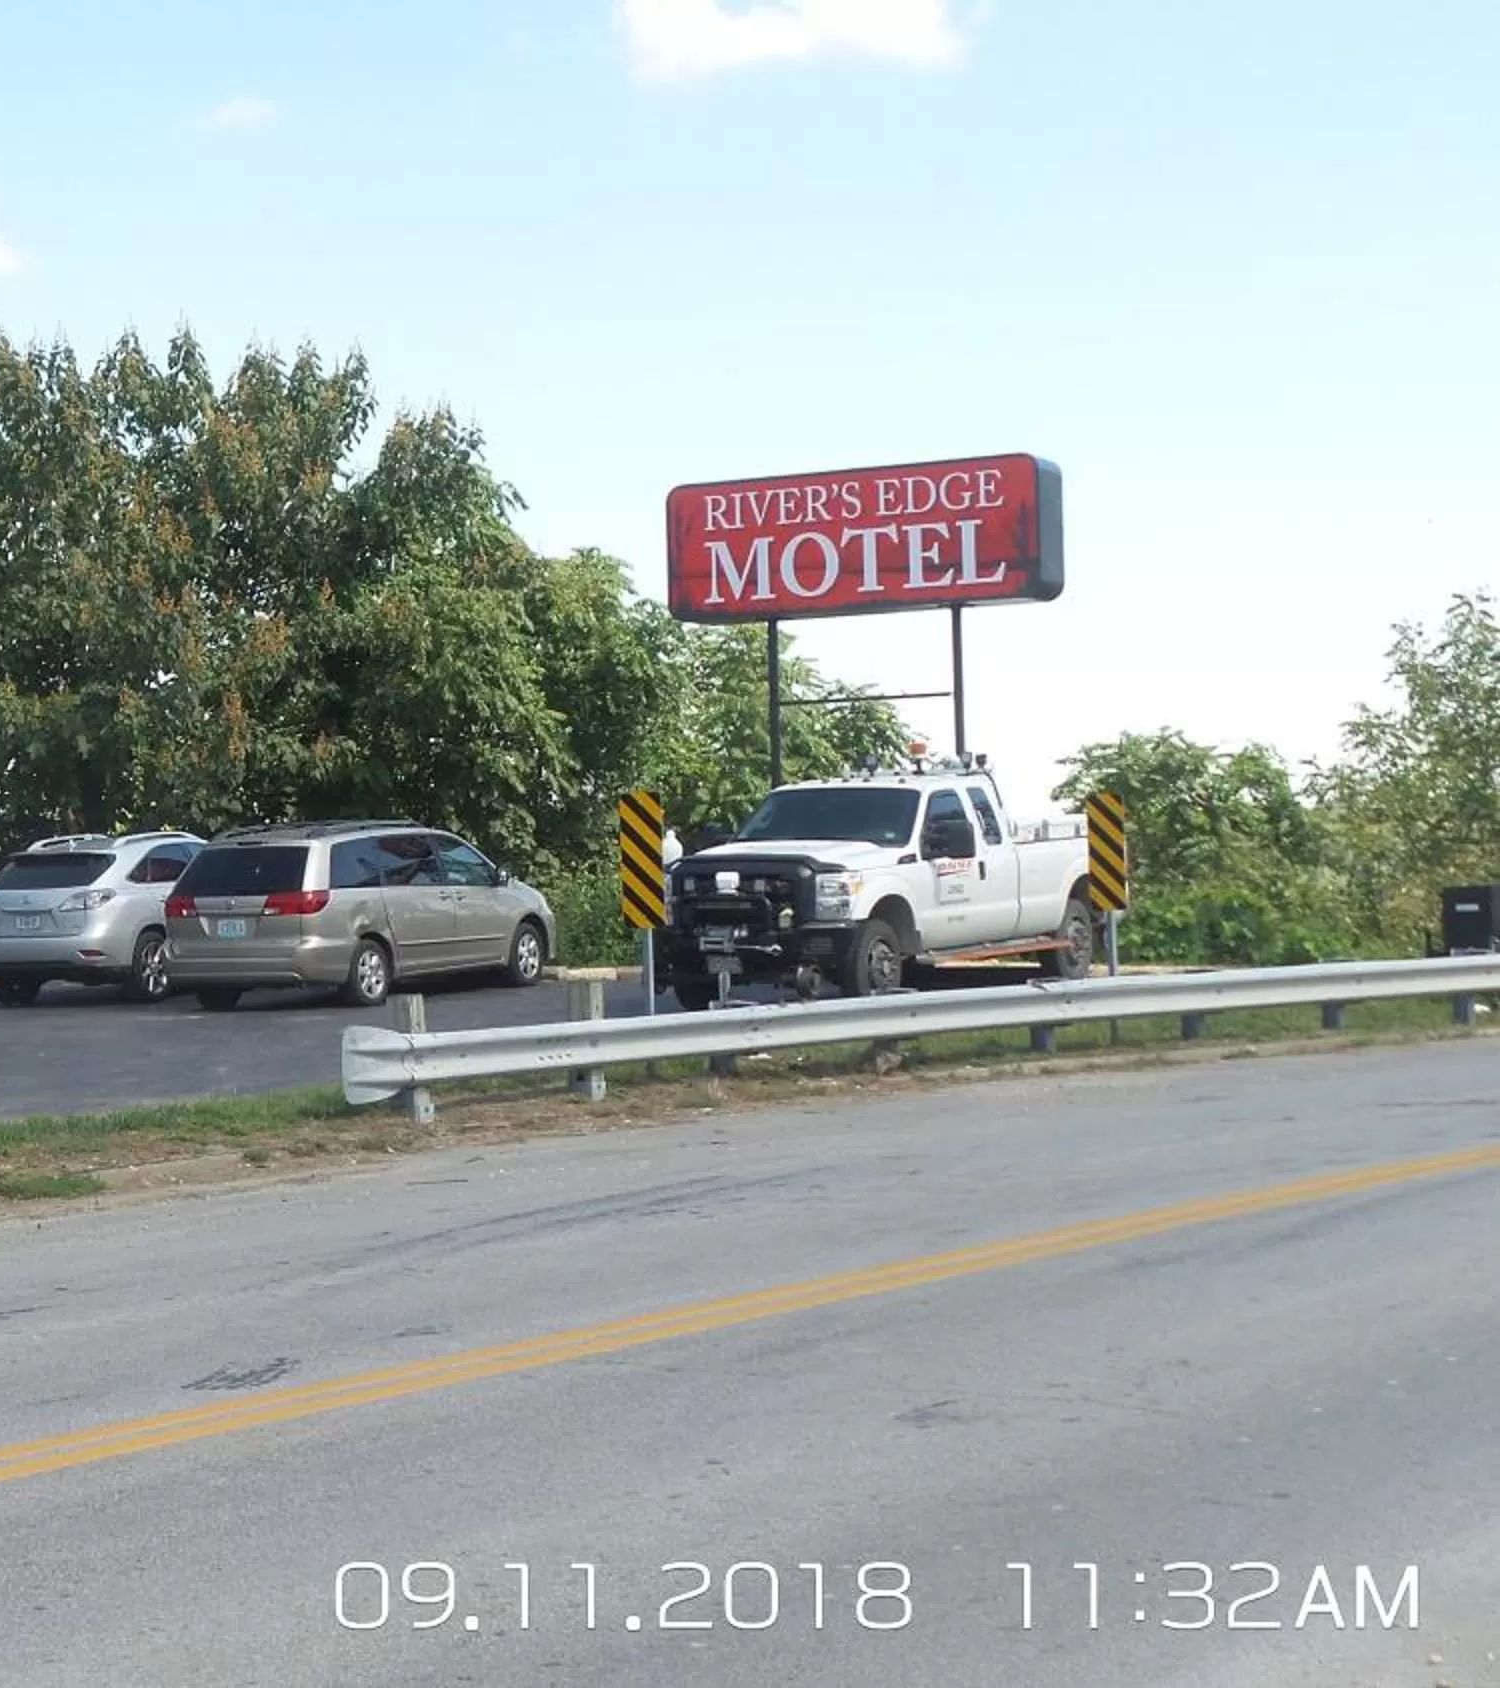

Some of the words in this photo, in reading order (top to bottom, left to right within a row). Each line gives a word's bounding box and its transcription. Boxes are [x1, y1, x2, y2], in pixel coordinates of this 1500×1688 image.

[704, 482, 861, 531] RIVER'S
[875, 469, 1005, 517] EDGE
[704, 519, 1007, 604] MOTEL
